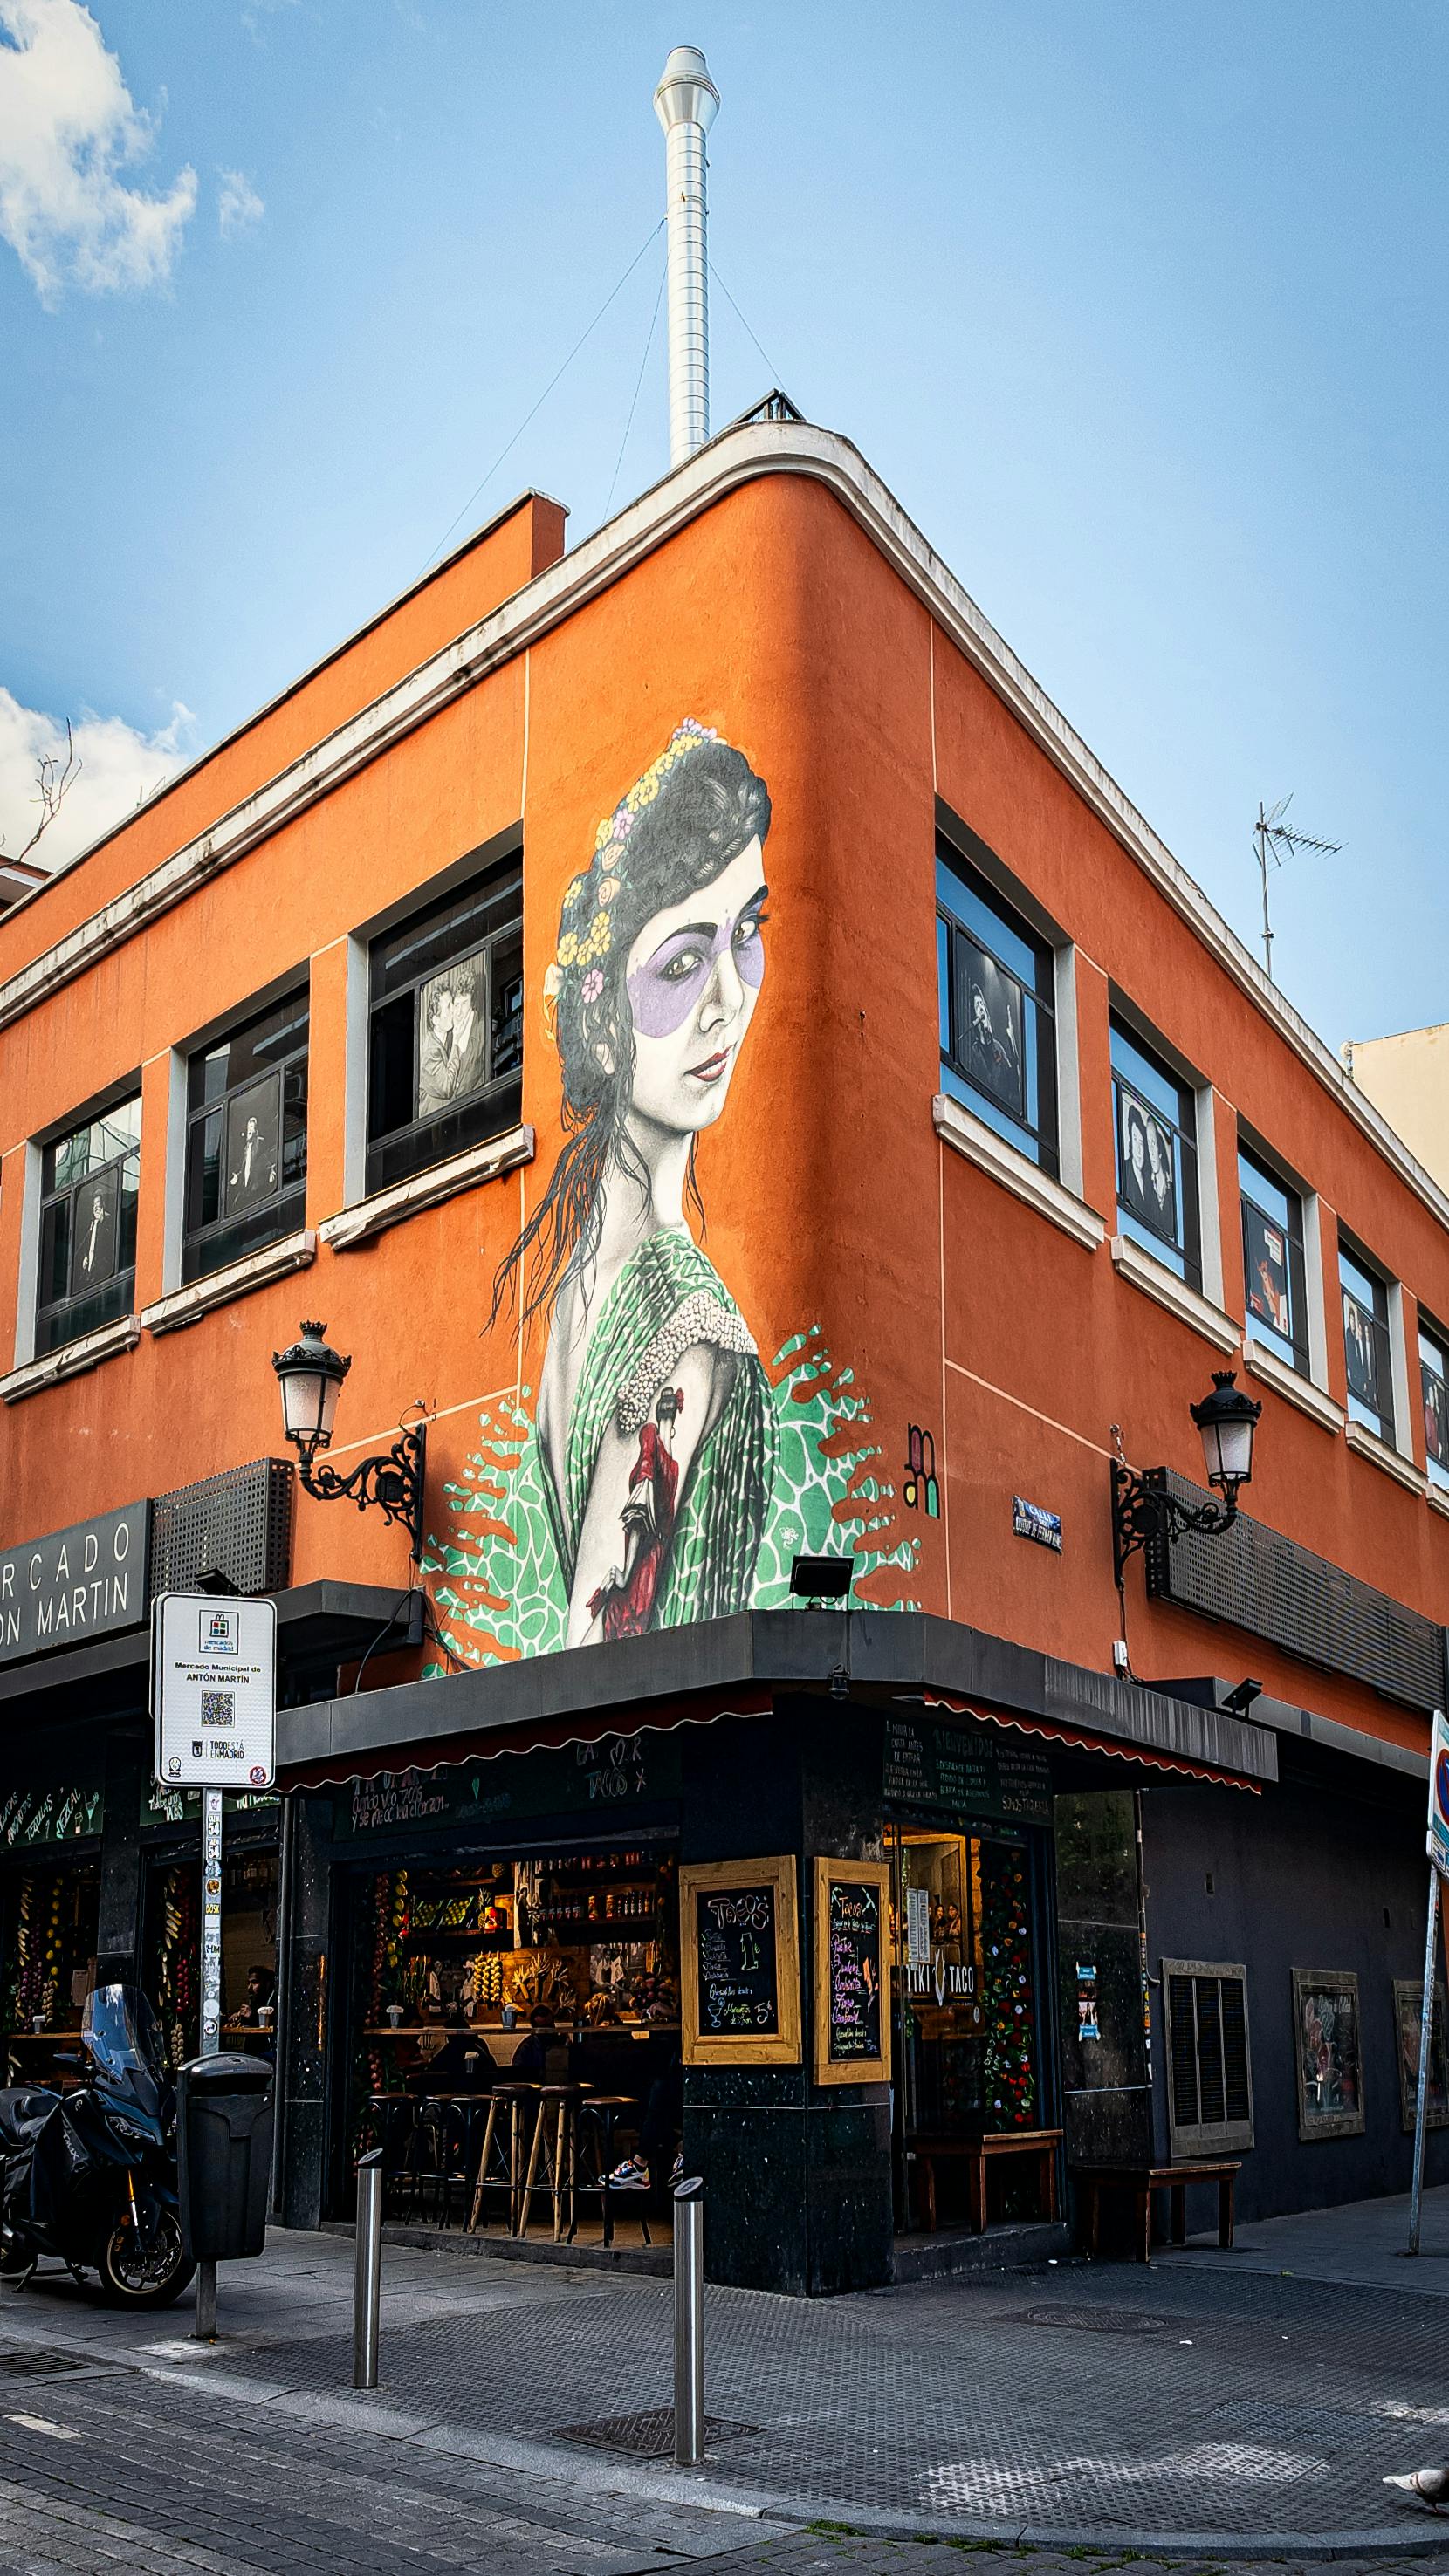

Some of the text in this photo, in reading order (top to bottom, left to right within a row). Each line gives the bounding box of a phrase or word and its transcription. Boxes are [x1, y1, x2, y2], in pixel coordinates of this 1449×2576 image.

[2, 1523, 129, 1600] RCADO
[38, 1572, 127, 1636] MARTIN
[175, 1661, 209, 1670] Mercado
[211, 1664, 250, 1673] Municipal
[186, 1673, 250, 1684] ANTÓN MARTÍN
[906, 1964, 973, 1993] TIKI TACO
[63, 2129, 80, 2161] TMAX
